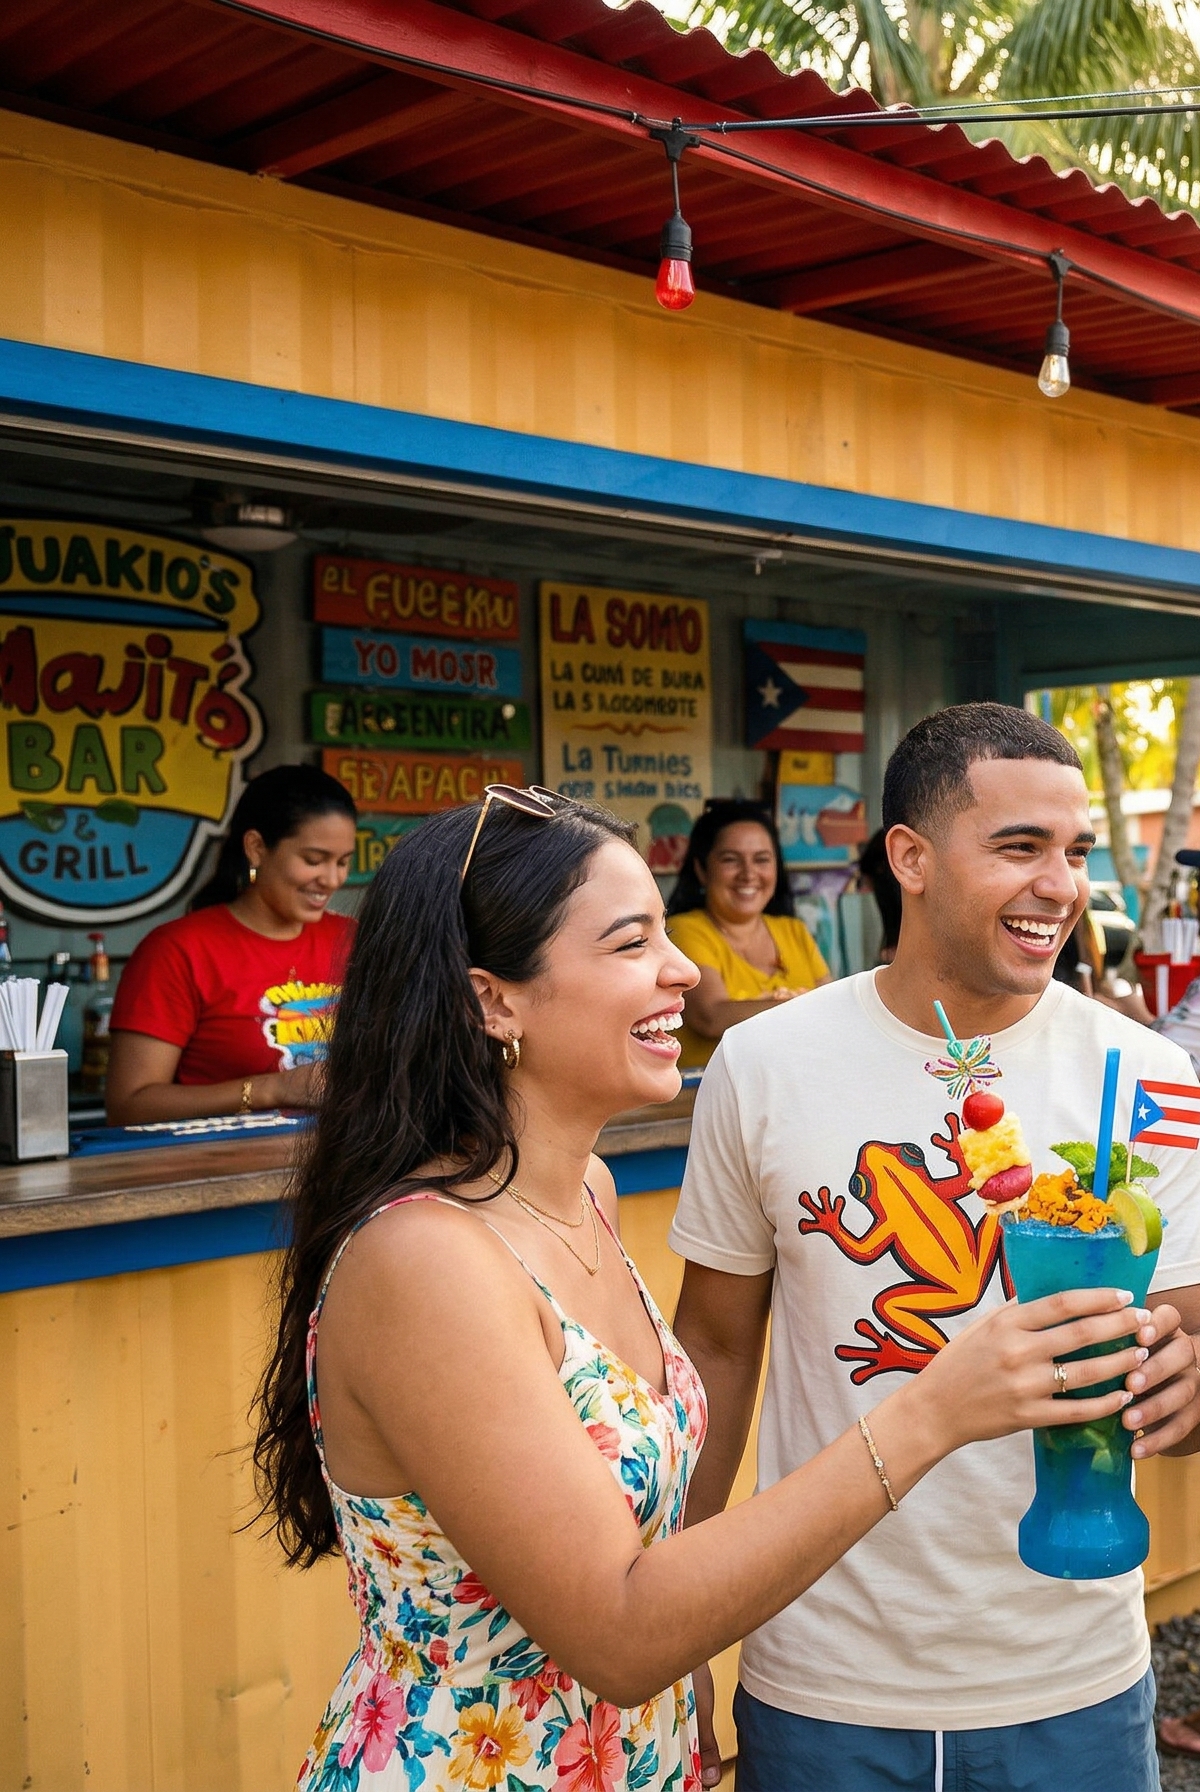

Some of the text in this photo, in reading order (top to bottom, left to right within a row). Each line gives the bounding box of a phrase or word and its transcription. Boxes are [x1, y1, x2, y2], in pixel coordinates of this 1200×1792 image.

[550, 593, 596, 644] LA
[354, 638, 398, 677] YO
[550, 659, 573, 682] LA
[631, 666, 653, 687] DE
[553, 690, 575, 711] LA
[7, 721, 167, 795] BAR
[562, 742, 592, 772] La
[74, 812, 97, 842] &
[19, 839, 149, 880] GRILL
